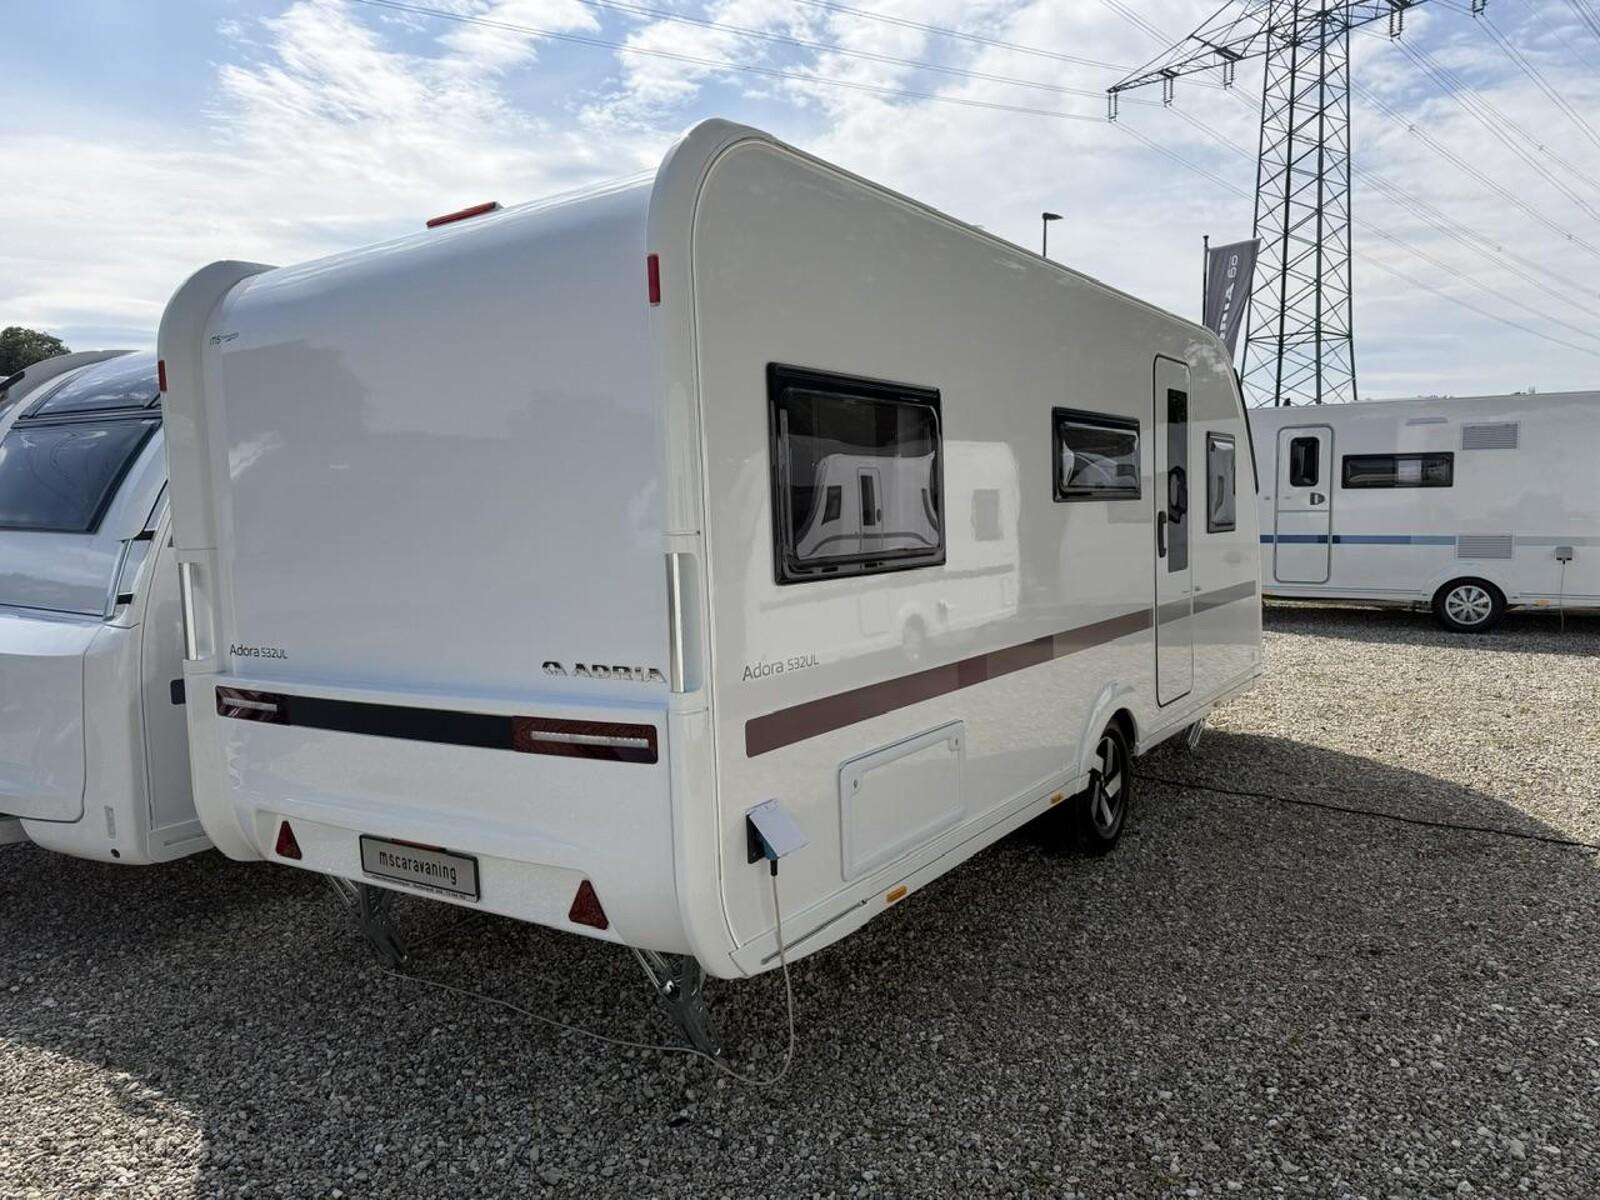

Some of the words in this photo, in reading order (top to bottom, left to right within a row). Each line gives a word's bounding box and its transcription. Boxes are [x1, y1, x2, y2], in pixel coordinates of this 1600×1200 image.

[229, 643, 260, 658] Adora
[260, 646, 289, 660] 532UL
[574, 662, 667, 682] ADRIA
[742, 660, 785, 682] Adora
[786, 654, 820, 671] 532UL
[379, 850, 458, 886] mscaravaning
